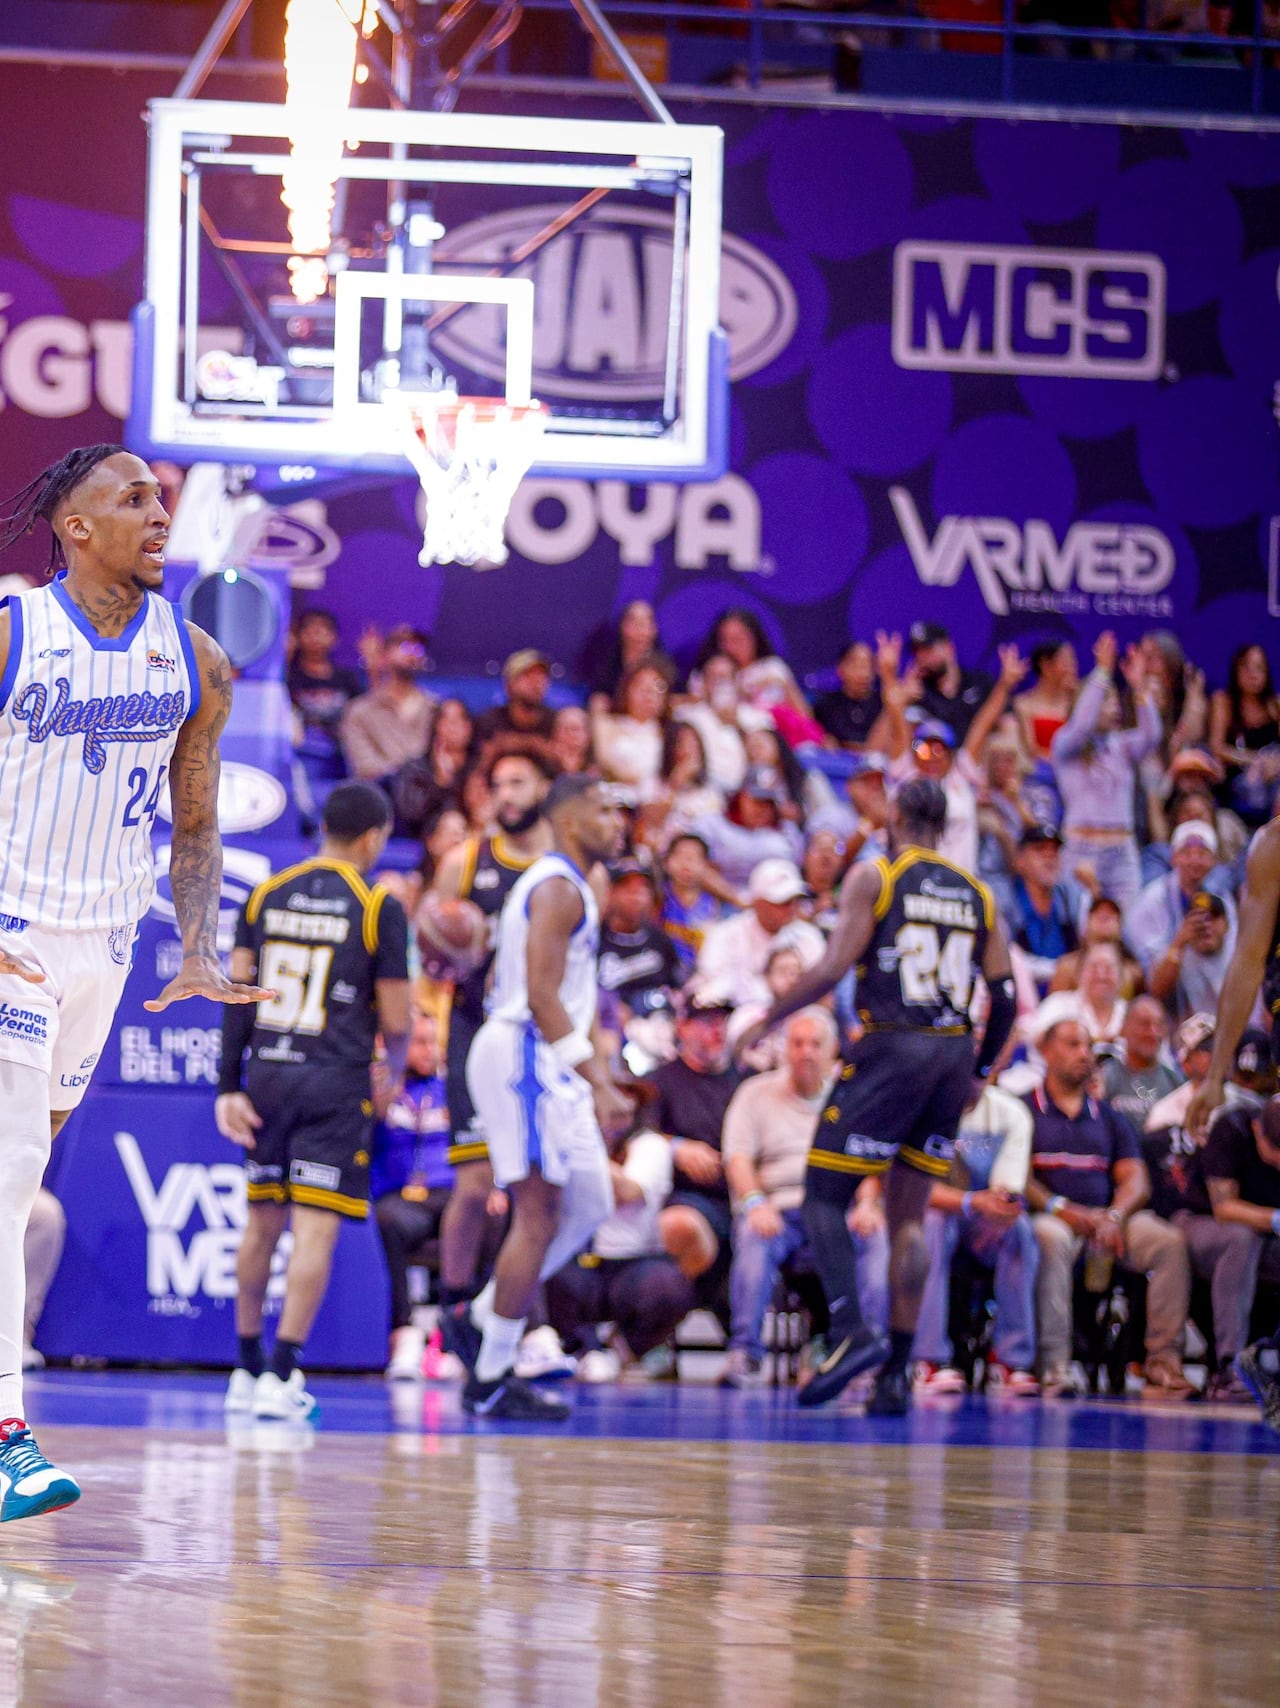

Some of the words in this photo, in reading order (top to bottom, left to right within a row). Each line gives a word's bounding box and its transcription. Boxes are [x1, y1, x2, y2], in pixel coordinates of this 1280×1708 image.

[910, 262, 1150, 360] MCS
[414, 474, 762, 572] OYA
[120, 1054, 179, 1082] DEL
